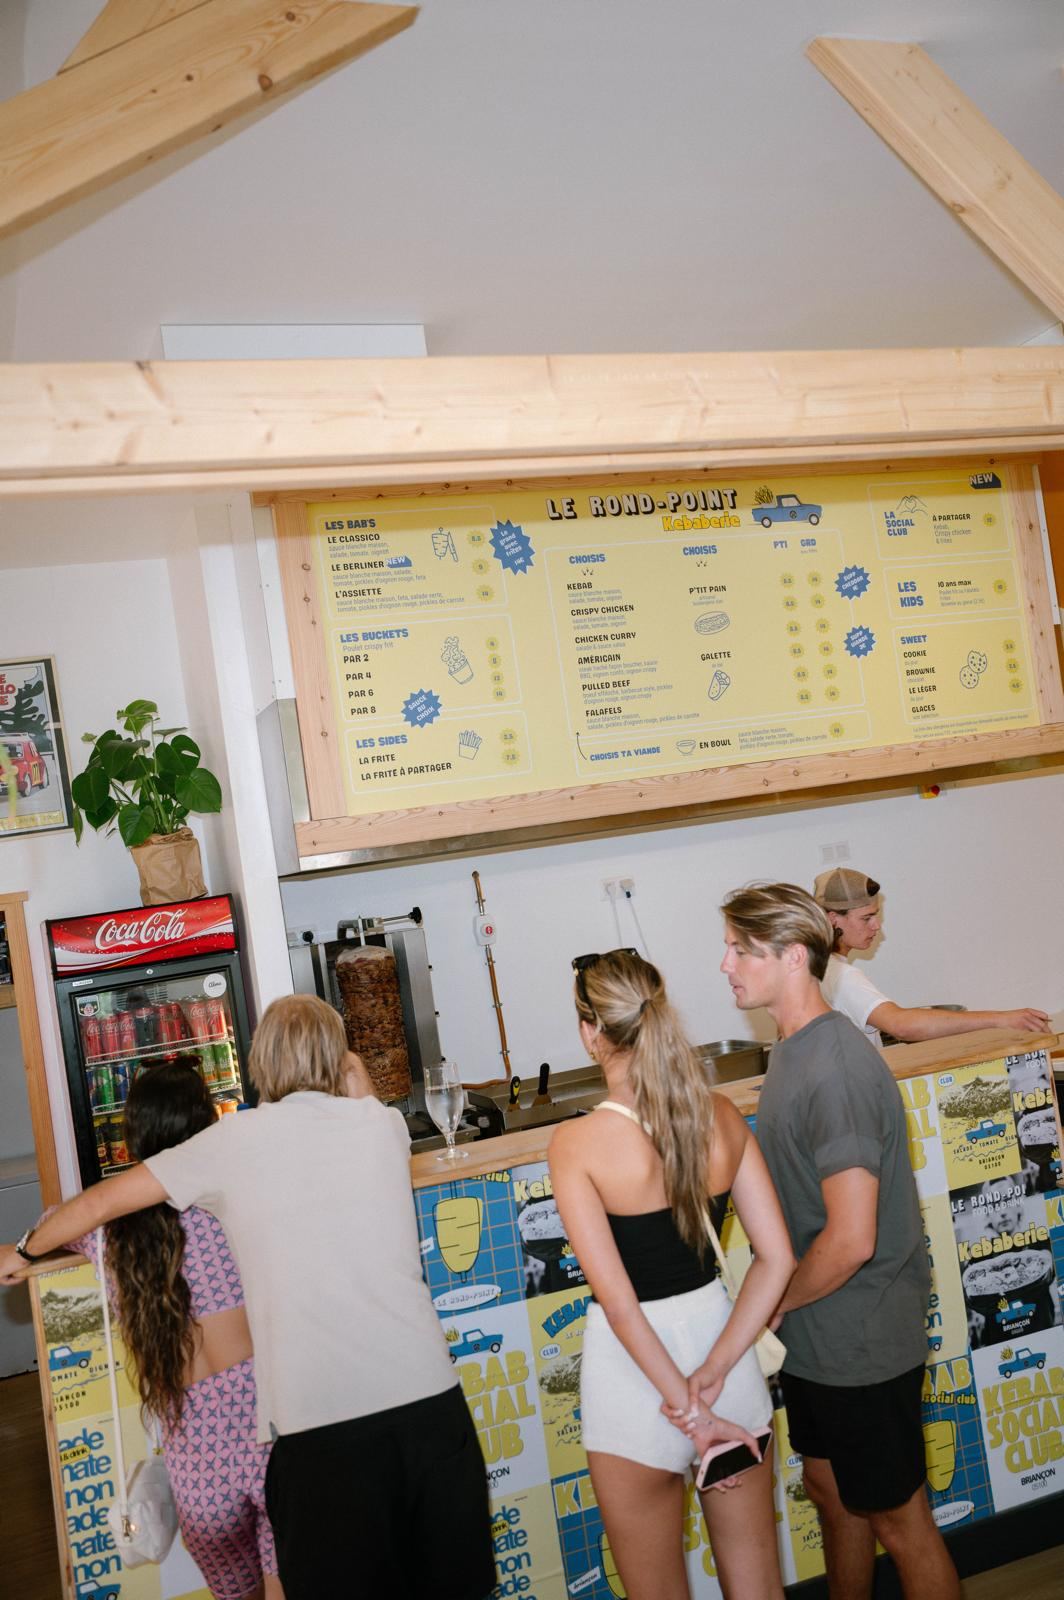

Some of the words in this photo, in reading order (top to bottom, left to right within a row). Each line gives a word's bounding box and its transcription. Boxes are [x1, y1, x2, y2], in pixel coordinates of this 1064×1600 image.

[970, 473, 993, 484] NEW
[546, 497, 577, 520] LE
[589, 489, 738, 517] ROND-POINT
[885, 511, 895, 519] LA
[938, 513, 971, 521] PARTAGER
[325, 521, 344, 530] LES
[347, 519, 376, 529] BAB'S
[662, 511, 740, 531] Kebaberie
[886, 519, 915, 528] SOCIAL
[888, 528, 908, 536] CLUB
[328, 536, 337, 544] LE
[339, 533, 380, 542] CLASSICO
[500, 534, 516, 545] grand
[801, 539, 816, 547] GRD
[506, 545, 522, 556] frites
[683, 545, 717, 556] CHOISIS
[774, 541, 787, 549] PTI
[332, 563, 341, 572] LE
[344, 561, 384, 570] BERLINER
[386, 556, 405, 565] NEW
[569, 554, 605, 564] CHOISIS
[567, 582, 593, 591] KEBAB
[689, 586, 708, 595] P'TIT
[709, 585, 726, 593] PAIN
[898, 582, 916, 592] LES
[336, 588, 382, 598] L'ASSIETTE
[900, 596, 924, 607] KIDS
[571, 607, 600, 616] CRISPY
[601, 604, 634, 614] CHICKEN
[340, 634, 359, 643] LES
[362, 629, 408, 641] BUCKETS
[575, 635, 608, 644] CHICKEN
[611, 632, 636, 640] CURRY
[901, 635, 927, 645] SWEET
[342, 644, 363, 653] Poulet
[364, 642, 382, 651] crispy
[344, 655, 361, 663] PAR
[363, 654, 369, 662] 2
[578, 654, 621, 664] AMÉRICAIN
[701, 651, 731, 661] GALETTE
[904, 650, 927, 658] COOKIE
[346, 672, 362, 681] PAR
[906, 667, 936, 676] BROWNIE
[582, 682, 610, 691] PULLED
[612, 680, 631, 688] BEEF
[918, 685, 937, 693] LÉGER
[348, 690, 366, 698] PAR
[408, 695, 428, 711] SAUCE
[351, 707, 368, 715] PAR
[371, 706, 376, 714] 8
[416, 707, 435, 722] CHOIX
[586, 707, 622, 717] FALAFELS
[912, 705, 935, 713] GLACES
[356, 739, 375, 749] LES
[379, 734, 408, 746] SIDES
[711, 739, 732, 748] BOWL
[359, 757, 369, 765] LA
[371, 754, 396, 763] FRITE
[590, 750, 619, 761] CHOISIS
[622, 749, 633, 757] TA
[635, 747, 660, 756] VIANDE
[361, 773, 371, 781] LA
[374, 769, 398, 779] FRITE
[400, 767, 406, 776] À
[408, 762, 452, 775] PARTAGER
[95, 908, 188, 950] Coca-Cola
[940, 1076, 952, 1084] CLUB
[979, 1139, 999, 1148] TOMATE
[953, 1145, 972, 1155] SALADE
[951, 1199, 966, 1213] LE
[958, 1222, 1049, 1262] Kebaberie
[1003, 1319, 1030, 1332] BRIANÇON
[542, 1347, 558, 1357] CLUB
[89, 1362, 120, 1373] OIGNN
[457, 1351, 529, 1396] BAB
[982, 1366, 1064, 1417] KEBAB
[956, 1393, 977, 1404] club
[557, 1424, 581, 1437] SALAD
[1005, 1430, 1064, 1473] CLUB
[1021, 1468, 1056, 1485] BRIANÇON
